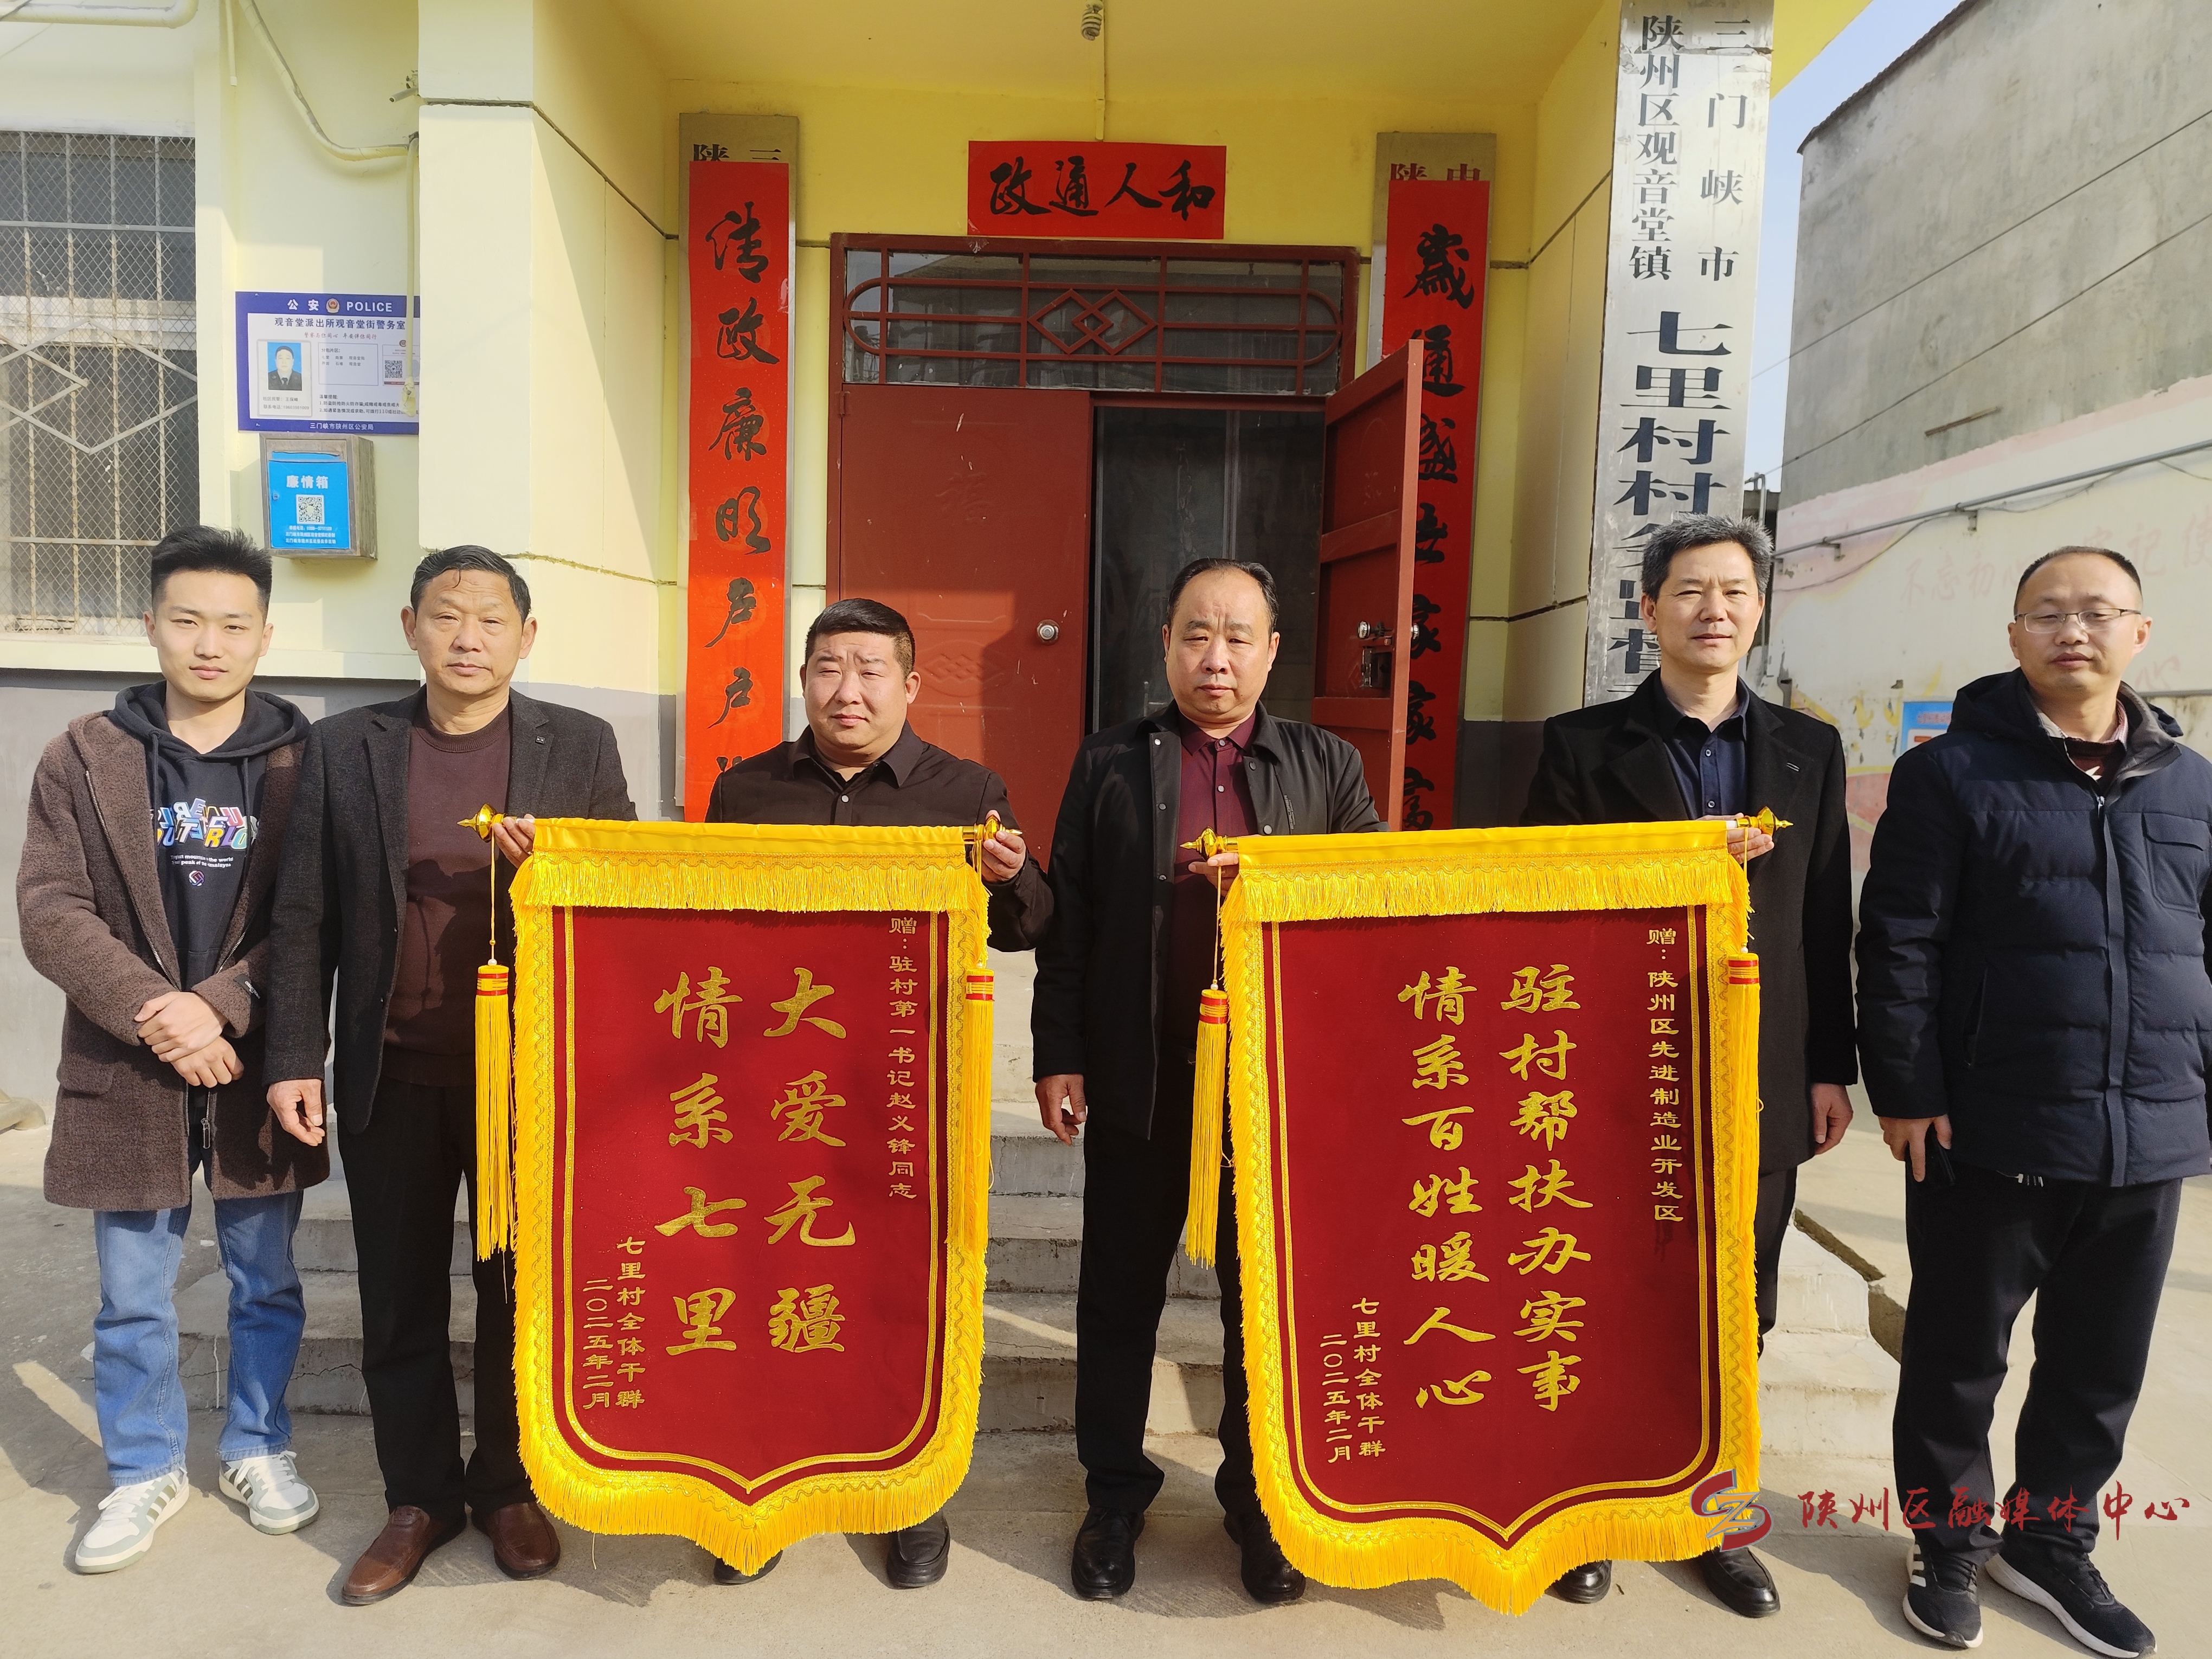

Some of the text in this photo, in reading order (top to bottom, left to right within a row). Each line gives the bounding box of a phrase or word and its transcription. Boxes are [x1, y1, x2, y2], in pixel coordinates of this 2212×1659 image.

[989, 155, 1215, 221] 政通人和
[1629, 15, 1684, 281] 陕州区观音堂镇
[1697, 19, 1751, 282] 三门峡市
[274, 317, 406, 330] 观音堂派出所观音堂街警务室
[346, 301, 393, 312] POLICE
[286, 475, 329, 489] 廉情箱
[310, 422, 374, 430] 三门峡市陕州区公安局
[705, 201, 780, 772] 清政廉明户户
[653, 965, 748, 1356] 情系七里
[763, 967, 856, 1354] 大爱无疆
[1397, 966, 1496, 1410] 情系百姓暖人心
[1499, 963, 1594, 1412] 驻村帮扶办实事
[615, 1236, 646, 1410] 七里村全体干群
[1352, 1297, 1386, 1458] 七里村全体干群
